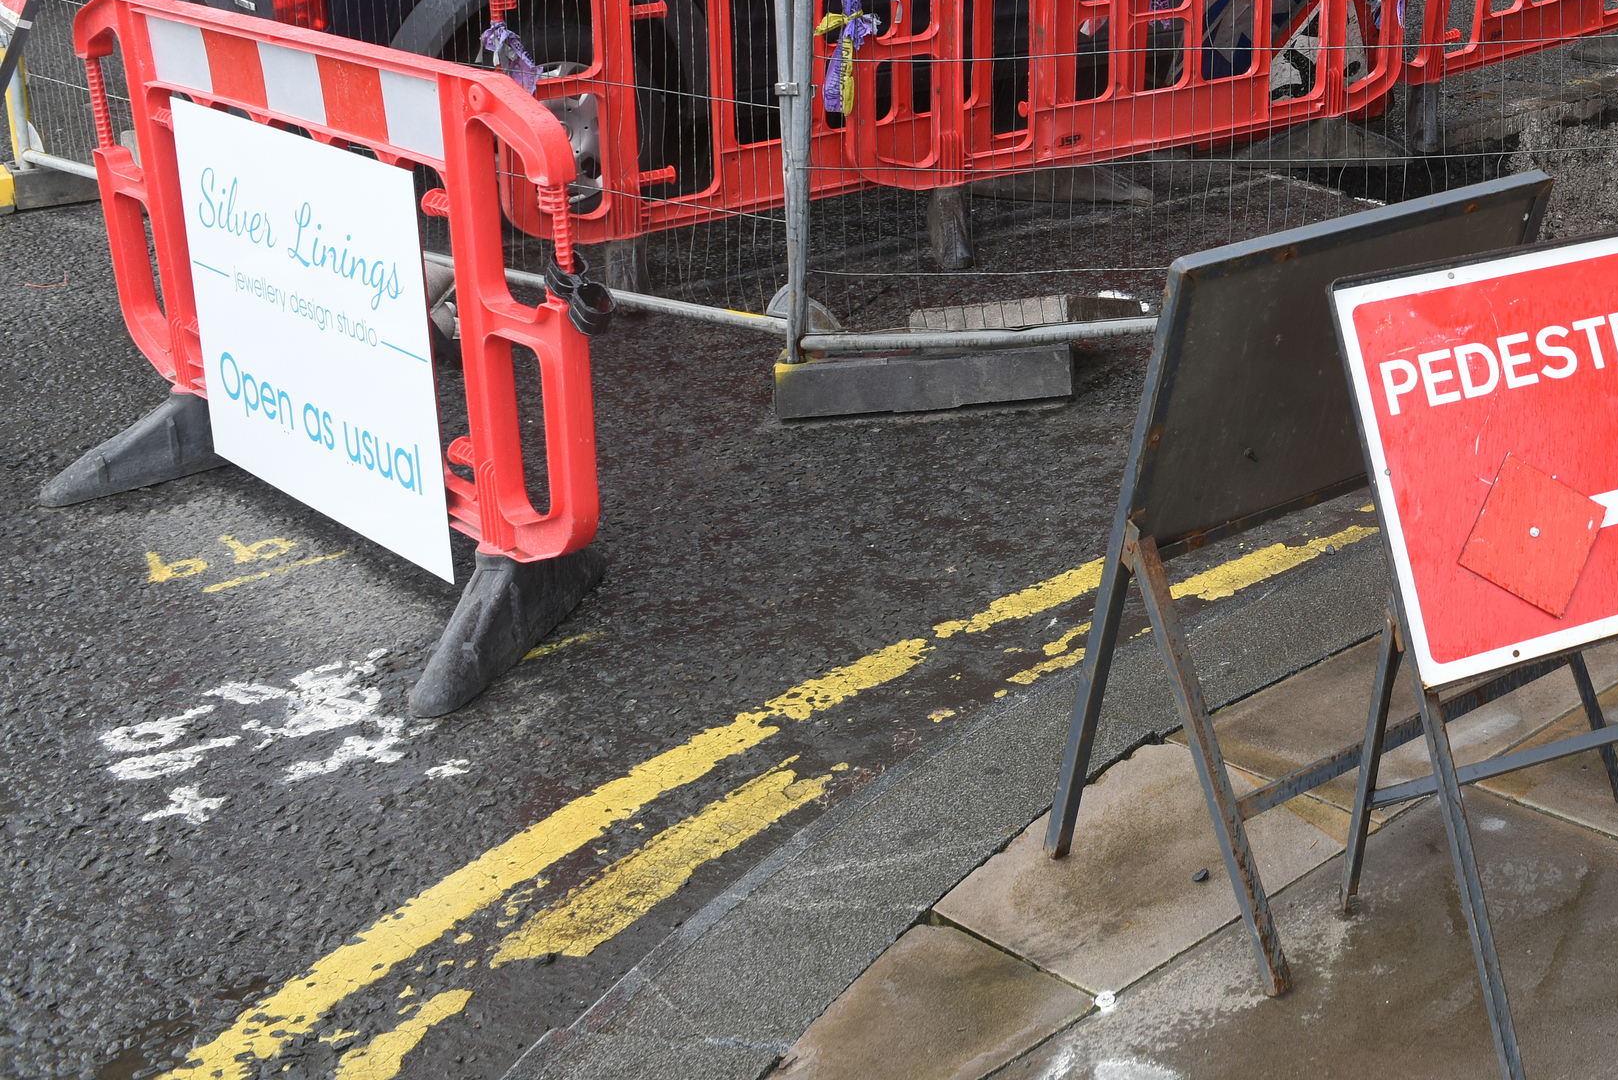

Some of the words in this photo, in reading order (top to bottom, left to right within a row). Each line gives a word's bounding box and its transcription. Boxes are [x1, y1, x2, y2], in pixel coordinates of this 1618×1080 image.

[1058, 132, 1083, 148] JSP
[199, 167, 278, 248] Silver
[287, 202, 405, 311] Linings
[233, 265, 287, 313] jewellery
[290, 291, 333, 331] design
[336, 311, 378, 347] studio
[220, 351, 294, 431] Open
[303, 402, 335, 450] as
[343, 421, 423, 495] usual
